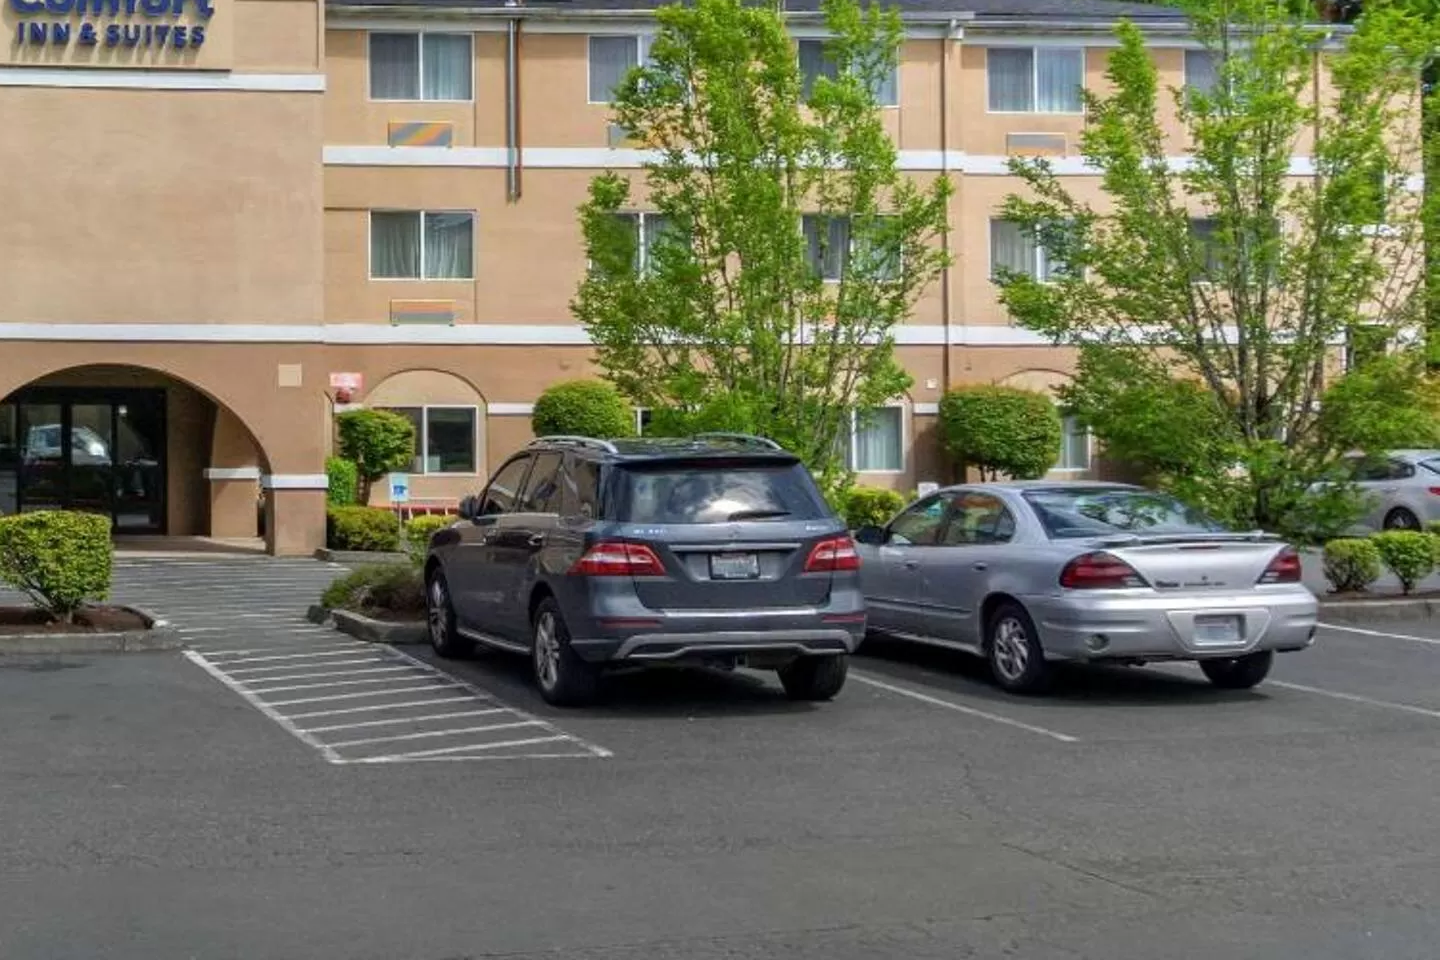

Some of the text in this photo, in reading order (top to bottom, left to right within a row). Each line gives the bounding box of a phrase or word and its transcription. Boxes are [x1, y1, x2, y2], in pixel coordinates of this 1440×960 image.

[18, 22, 205, 49] INN & SUITES
